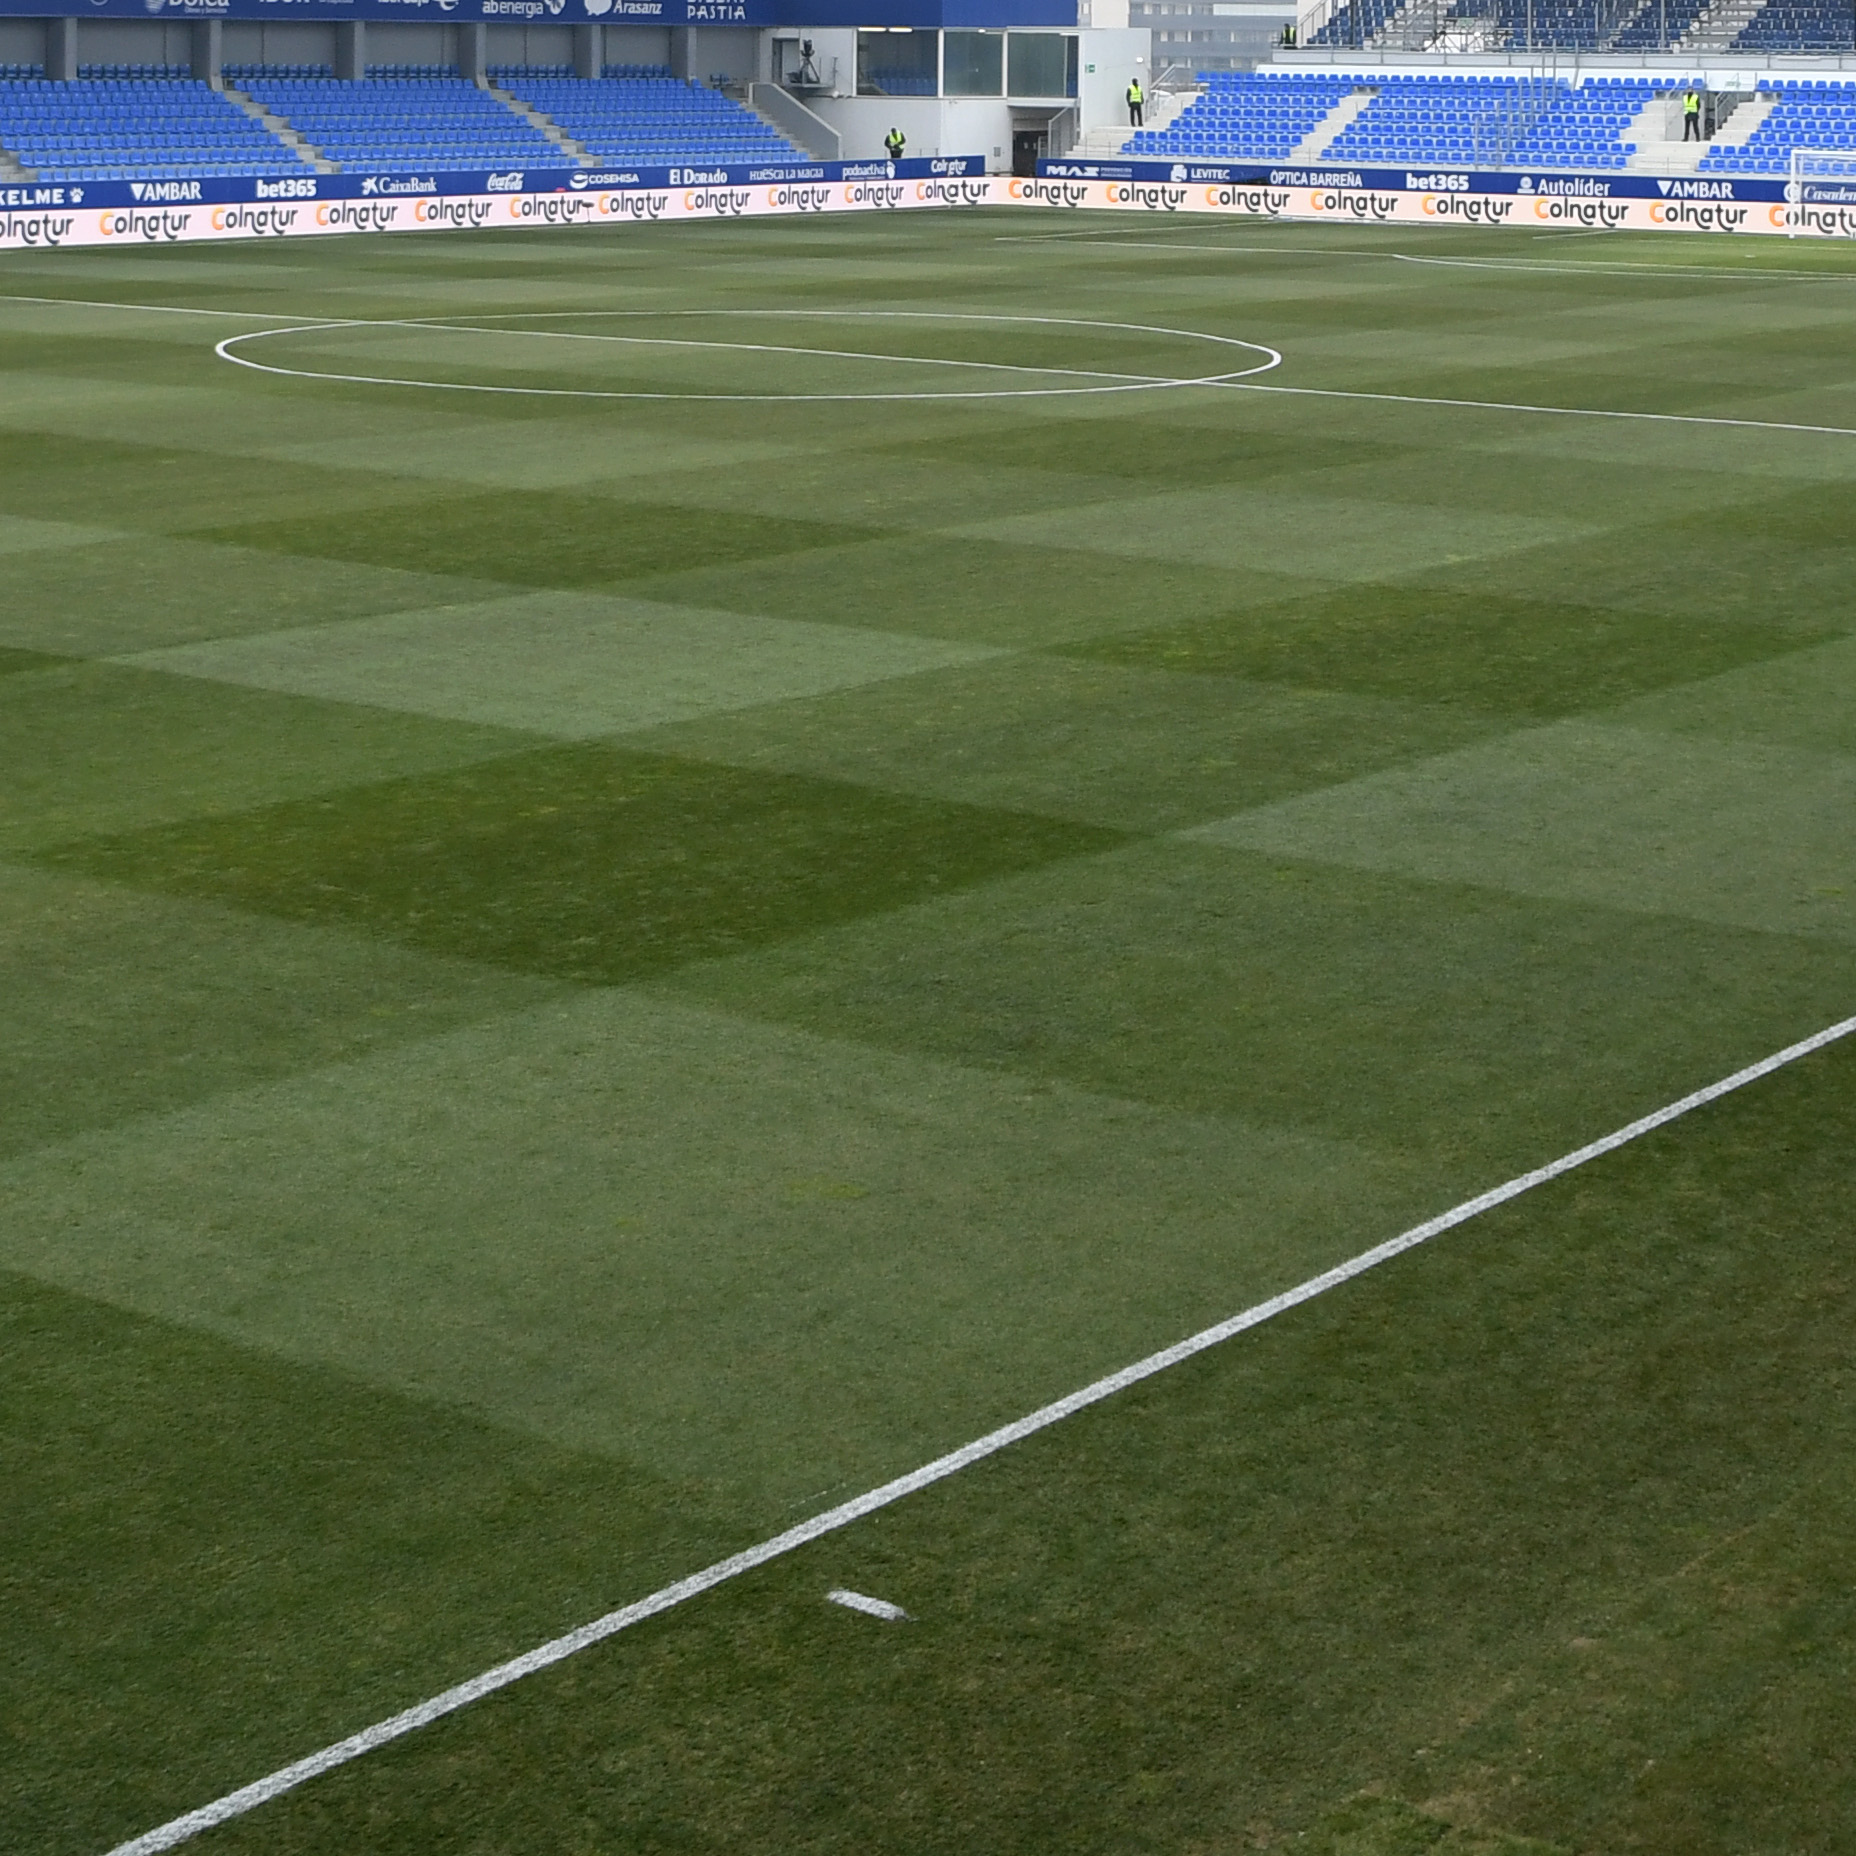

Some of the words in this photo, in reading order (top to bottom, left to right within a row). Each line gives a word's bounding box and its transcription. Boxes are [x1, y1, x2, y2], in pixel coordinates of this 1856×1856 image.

[613, 1, 662, 15] Arasanz
[687, 5, 746, 21] PASTIA
[379, 177, 437, 193] CaixaBank
[589, 173, 639, 184] COSEHISA
[1191, 168, 1230, 180] LEVITEC
[1310, 171, 1362, 187] BARREÑA
[1406, 173, 1469, 191] bet365
[144, 181, 202, 201] AMBAR
[256, 179, 317, 198] bet365
[768, 185, 831, 210] Colnatur
[845, 182, 904, 207] Colnatur
[917, 179, 990, 204] Colnatur
[1008, 179, 1088, 207] Colnatur
[1106, 183, 1187, 210] Colnatur
[1537, 177, 1611, 197] Autolíder
[1670, 180, 1734, 199] AMBAR
[415, 198, 492, 226] Colnatur
[510, 194, 583, 223] Colnatur
[599, 192, 668, 219] Colnatur
[685, 188, 751, 214] Colnatur
[1205, 186, 1290, 214] Colnatur
[1311, 189, 1398, 219] Colnatur
[1421, 194, 1513, 223] Colnatur
[1534, 198, 1629, 227] Colnatur
[100, 209, 191, 240] Colnatur
[211, 204, 298, 234] Colnatur
[316, 201, 398, 230] Colnatur
[1649, 201, 1748, 231] Colnatur
